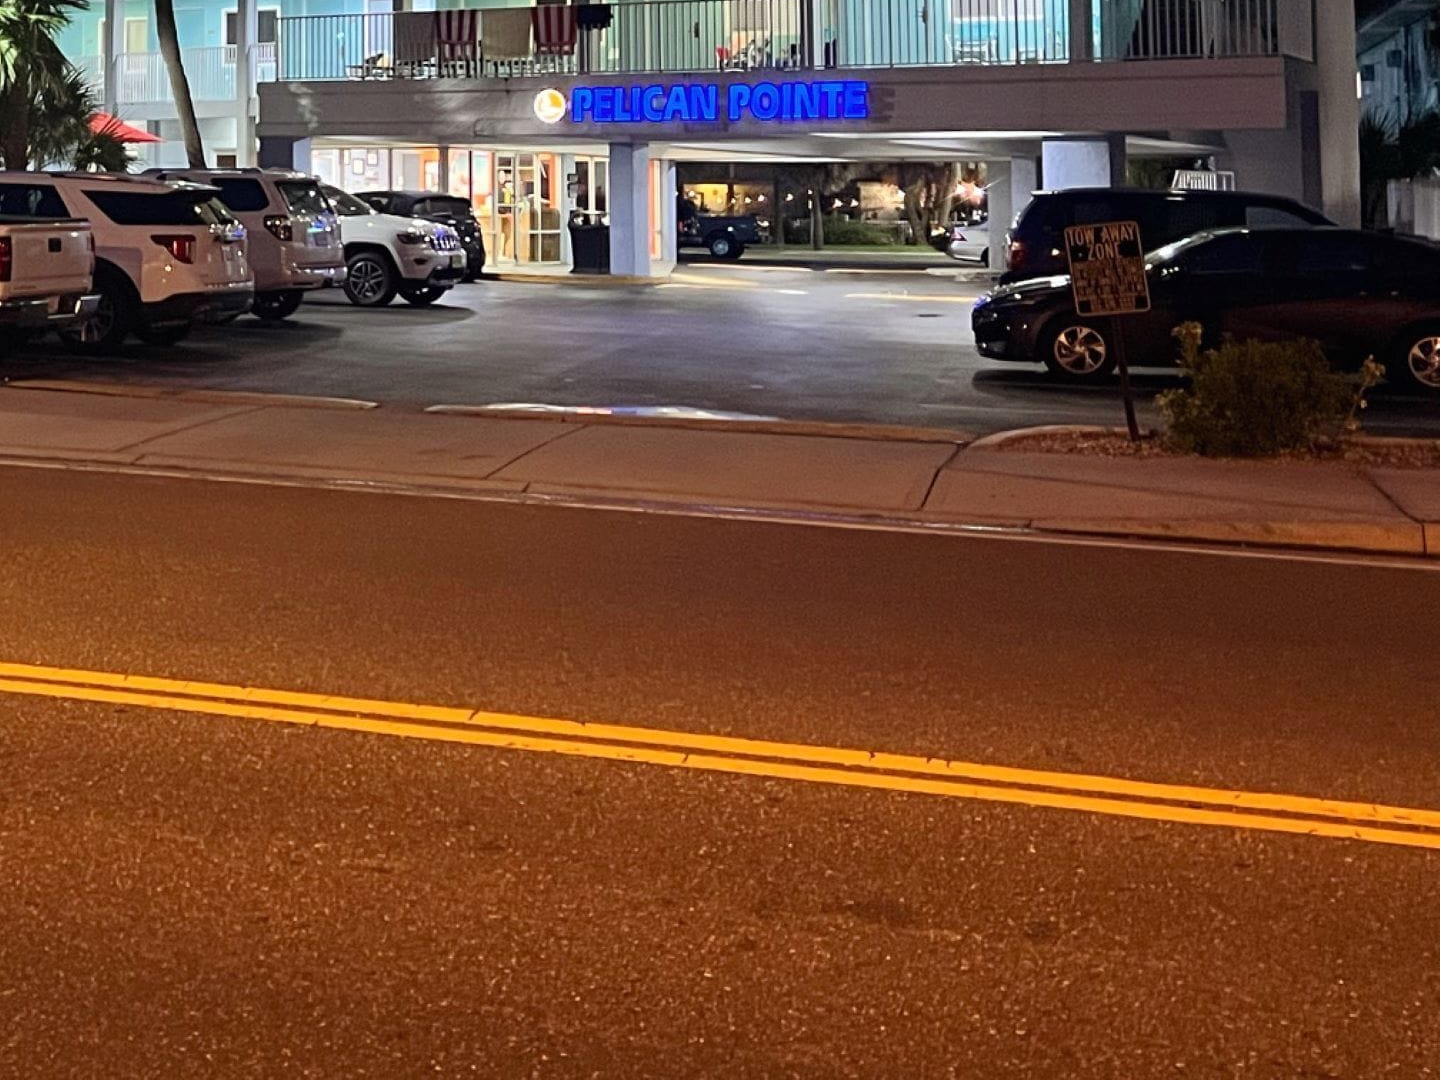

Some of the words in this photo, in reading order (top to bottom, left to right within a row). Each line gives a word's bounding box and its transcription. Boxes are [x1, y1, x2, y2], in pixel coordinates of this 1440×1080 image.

[573, 85, 718, 122] PELICAN
[728, 81, 867, 119] POINTE
[1068, 227, 1095, 247] TOW
[1101, 224, 1135, 242] AWAY
